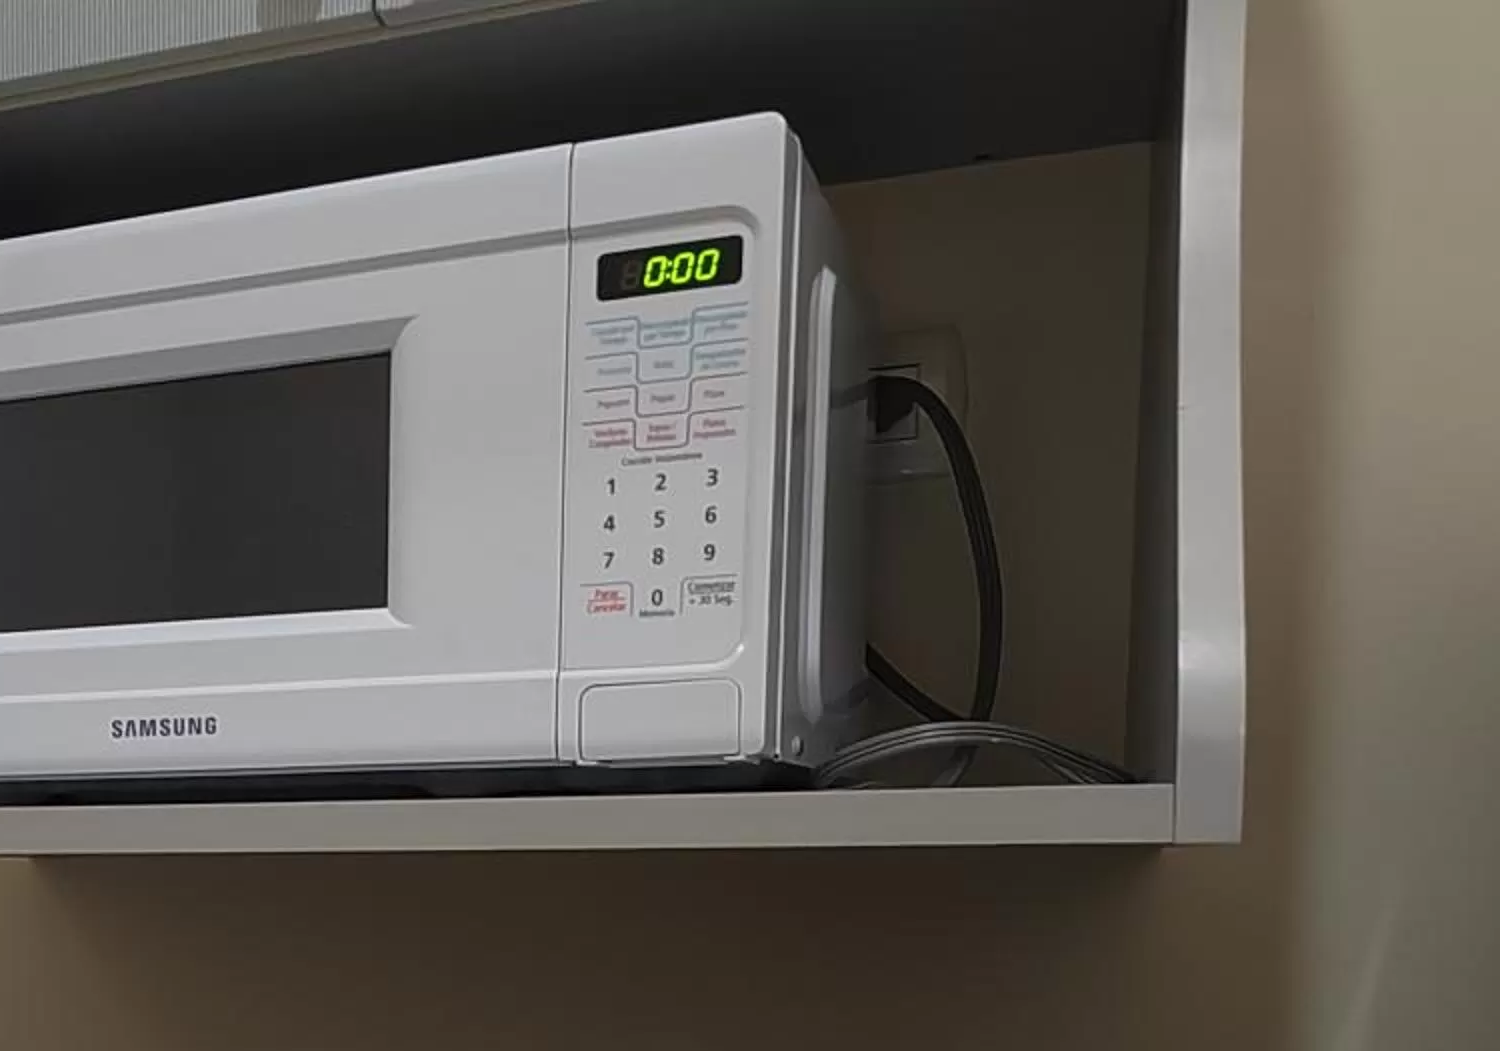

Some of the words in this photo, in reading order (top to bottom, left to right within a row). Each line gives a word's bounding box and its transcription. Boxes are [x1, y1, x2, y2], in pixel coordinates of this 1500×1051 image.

[643, 248, 721, 288] 0:00
[606, 477, 616, 495] 1
[654, 472, 668, 492] 2
[705, 467, 719, 488] 3
[603, 514, 616, 532] 4
[653, 509, 666, 529] 5
[704, 505, 718, 524] 6
[603, 551, 615, 569] 7
[651, 547, 665, 566] 8
[703, 543, 716, 561] 9
[651, 588, 664, 607] 0
[111, 717, 217, 738] SAMSUNG
